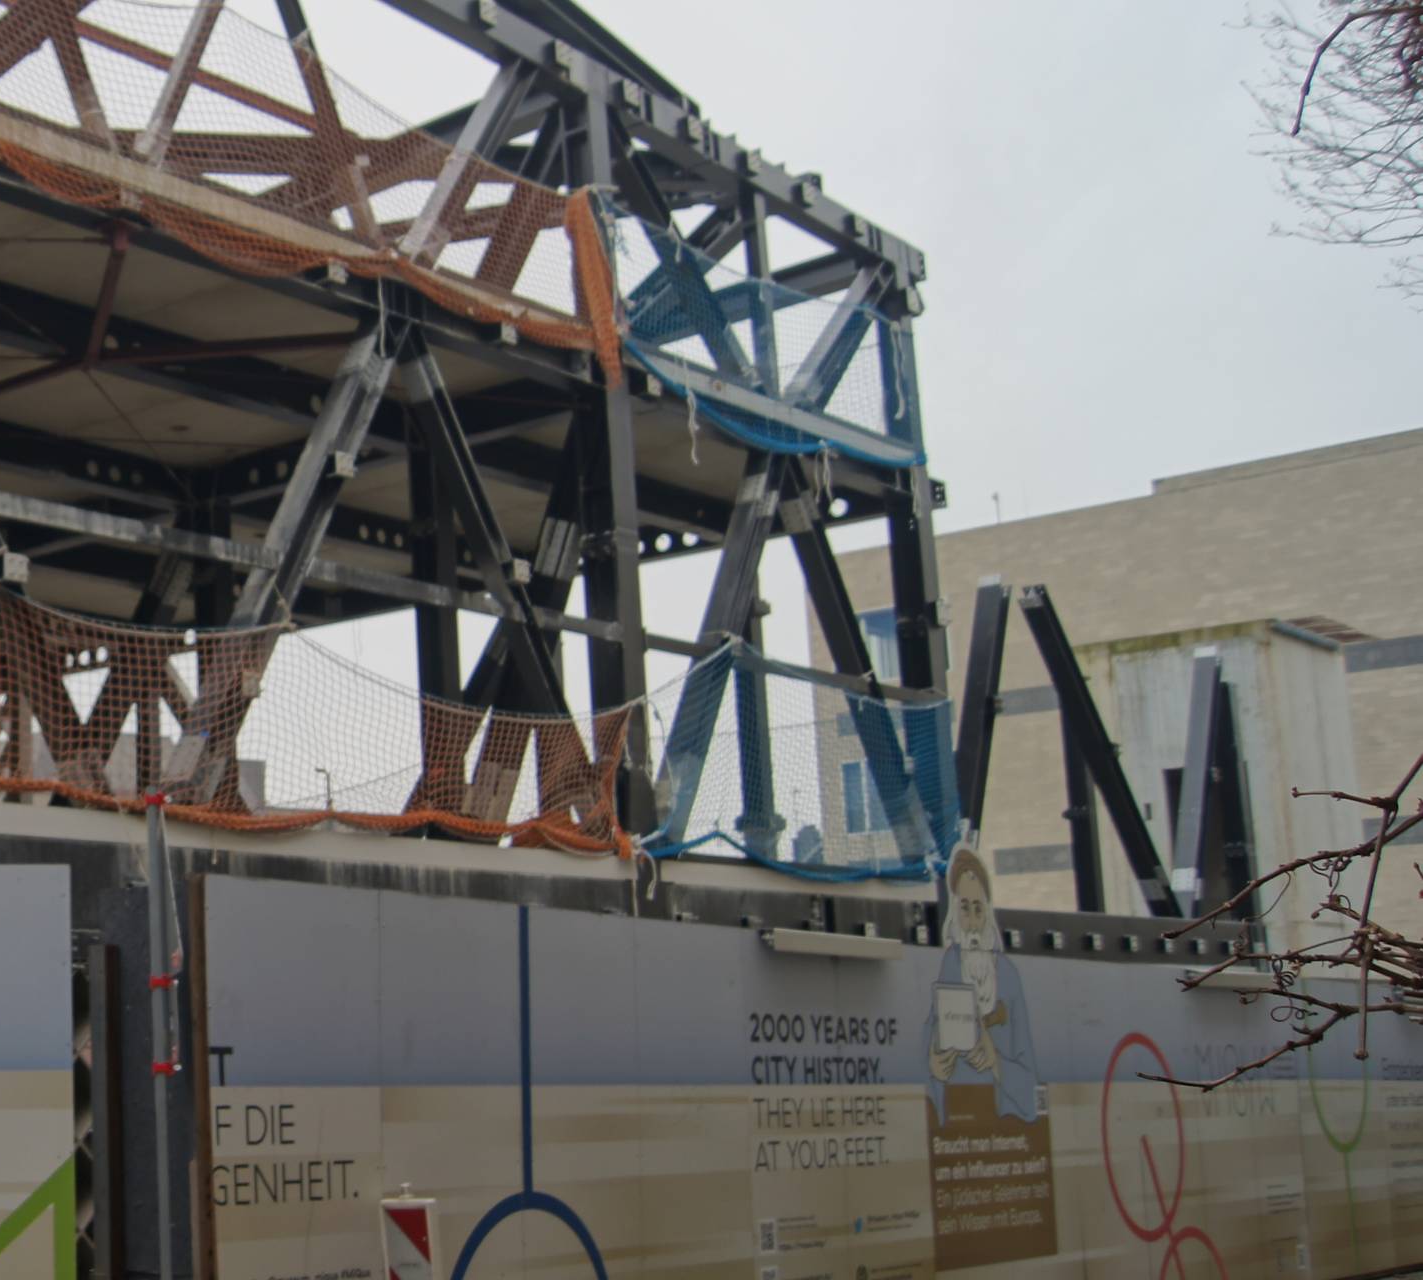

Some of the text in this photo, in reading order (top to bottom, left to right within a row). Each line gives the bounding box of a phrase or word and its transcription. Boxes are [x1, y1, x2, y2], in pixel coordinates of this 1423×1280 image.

[749, 1012, 898, 1046] 2000 YEARS OF
[751, 1054, 885, 1087] CITY HISTORY.
[215, 1104, 296, 1146] F DIE
[753, 1096, 886, 1129] THEY LIE HERE
[755, 1136, 889, 1173] AT YOUR FEET.
[211, 1159, 360, 1206] GENHEIT.
